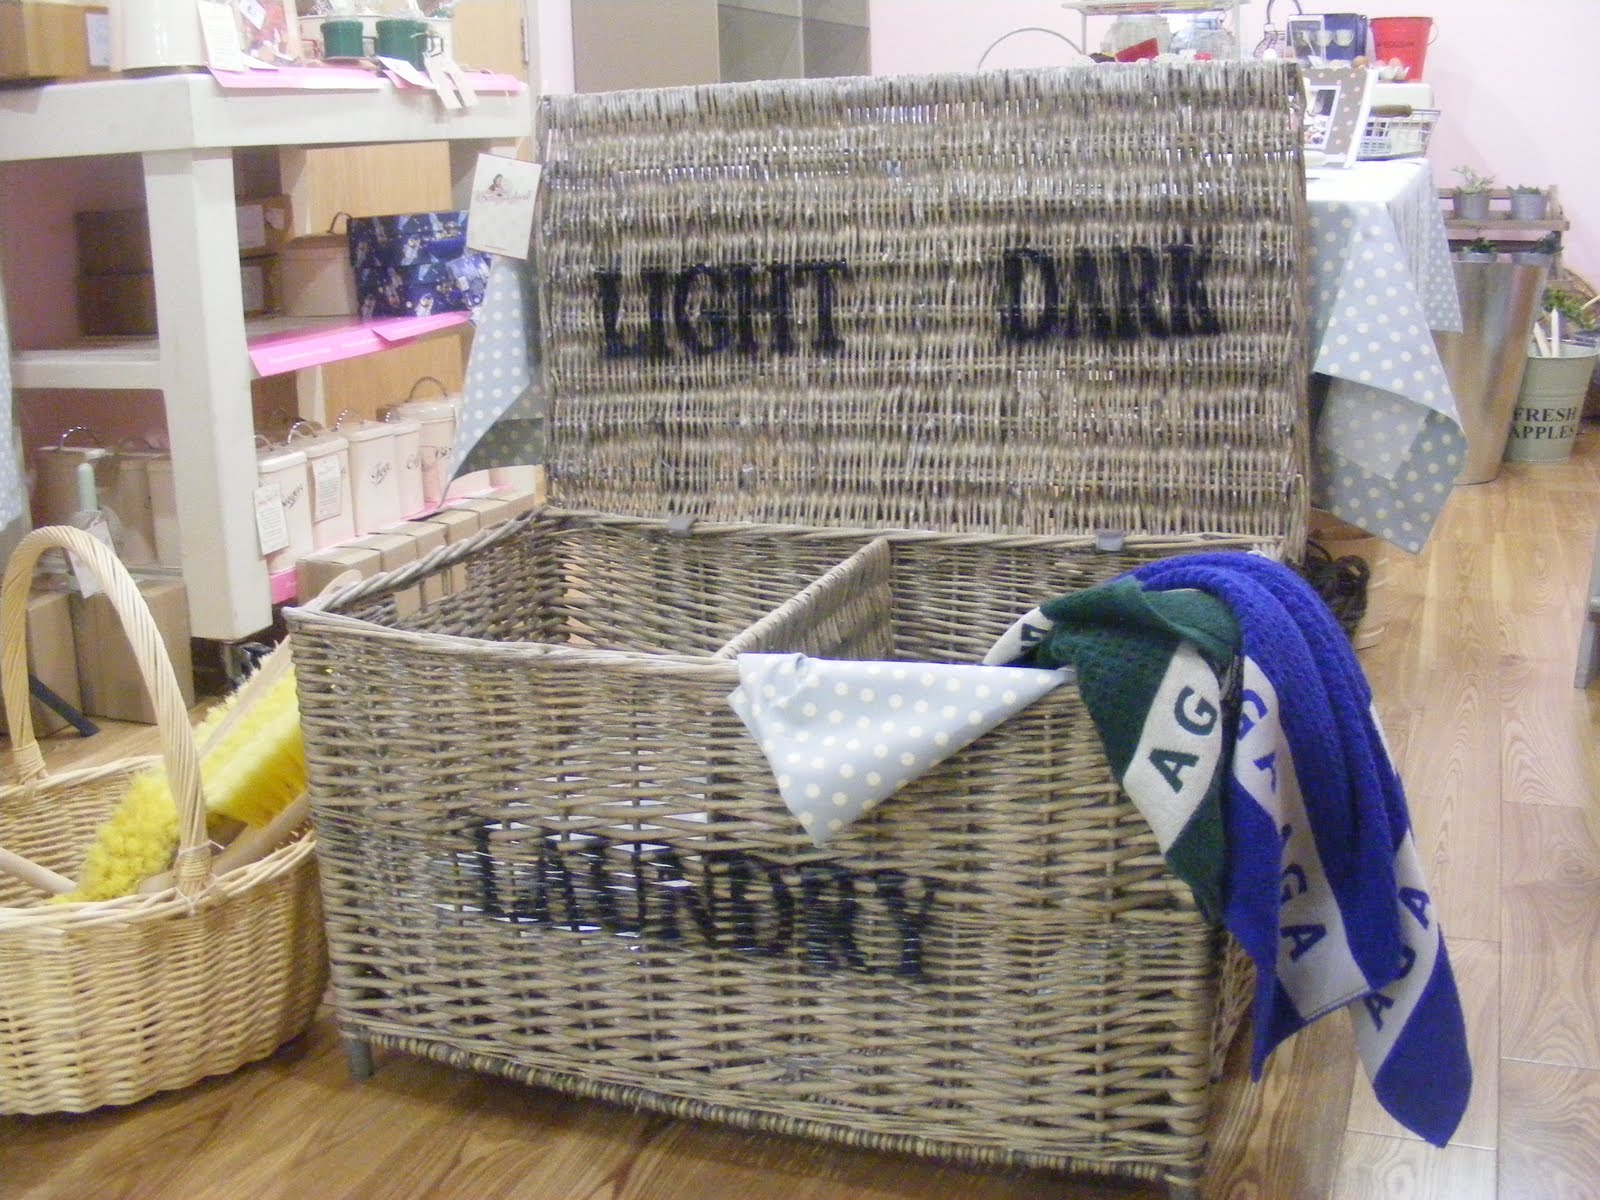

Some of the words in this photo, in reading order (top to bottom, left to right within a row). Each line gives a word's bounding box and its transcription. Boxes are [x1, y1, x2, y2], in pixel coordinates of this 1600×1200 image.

[597, 260, 847, 358] LIGHT
[1000, 245, 1221, 342] DARK
[1513, 406, 1577, 422] FRESH
[474, 820, 937, 982] LAUNDRY
